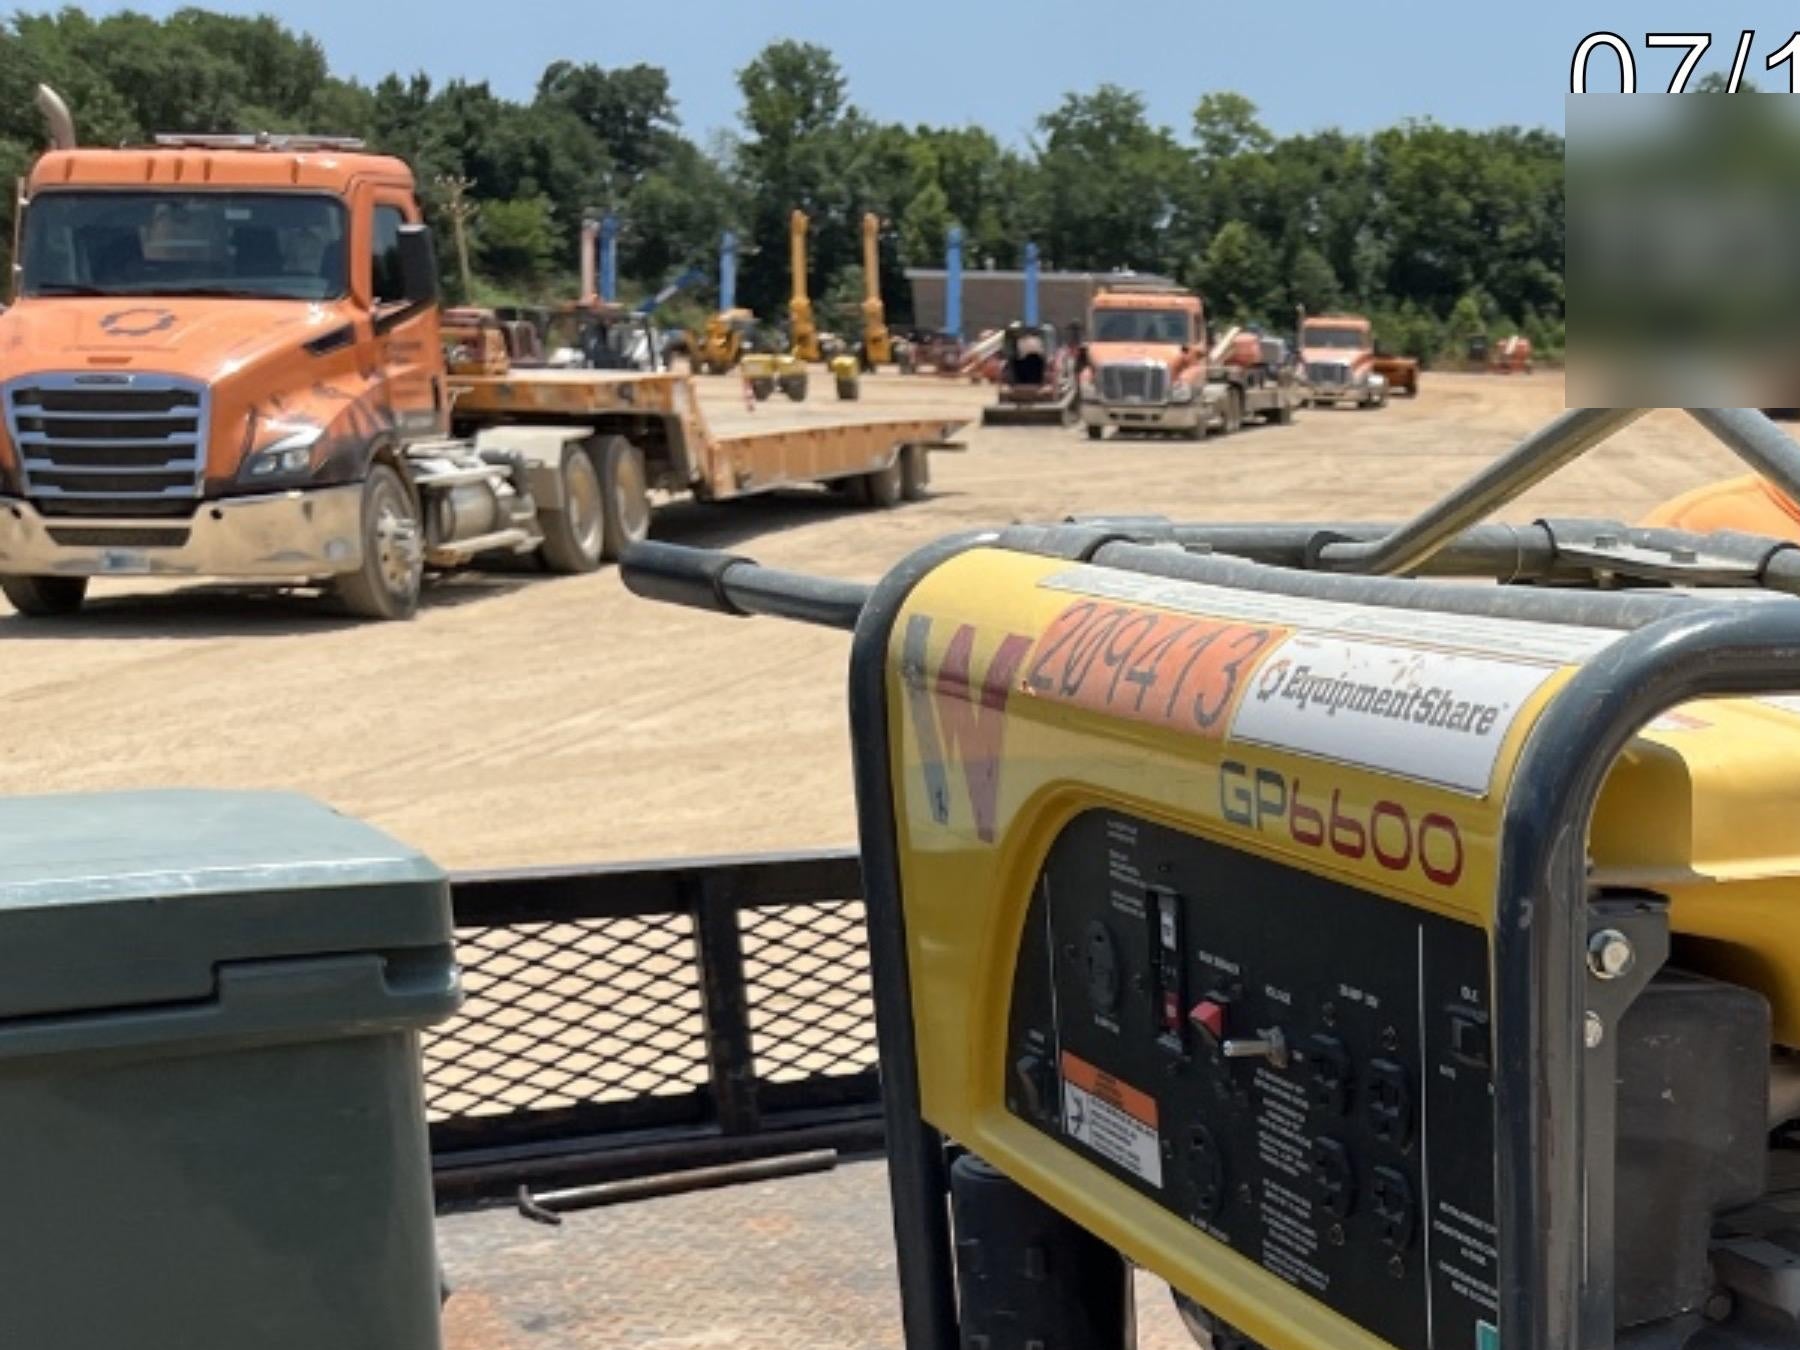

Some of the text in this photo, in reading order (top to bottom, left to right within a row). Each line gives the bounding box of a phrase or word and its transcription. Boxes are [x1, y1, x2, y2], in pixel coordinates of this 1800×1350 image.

[1030, 602, 1271, 729] 209413
[1280, 664, 1499, 736] EquipmentShare
[1219, 760, 1463, 887] GP6600
